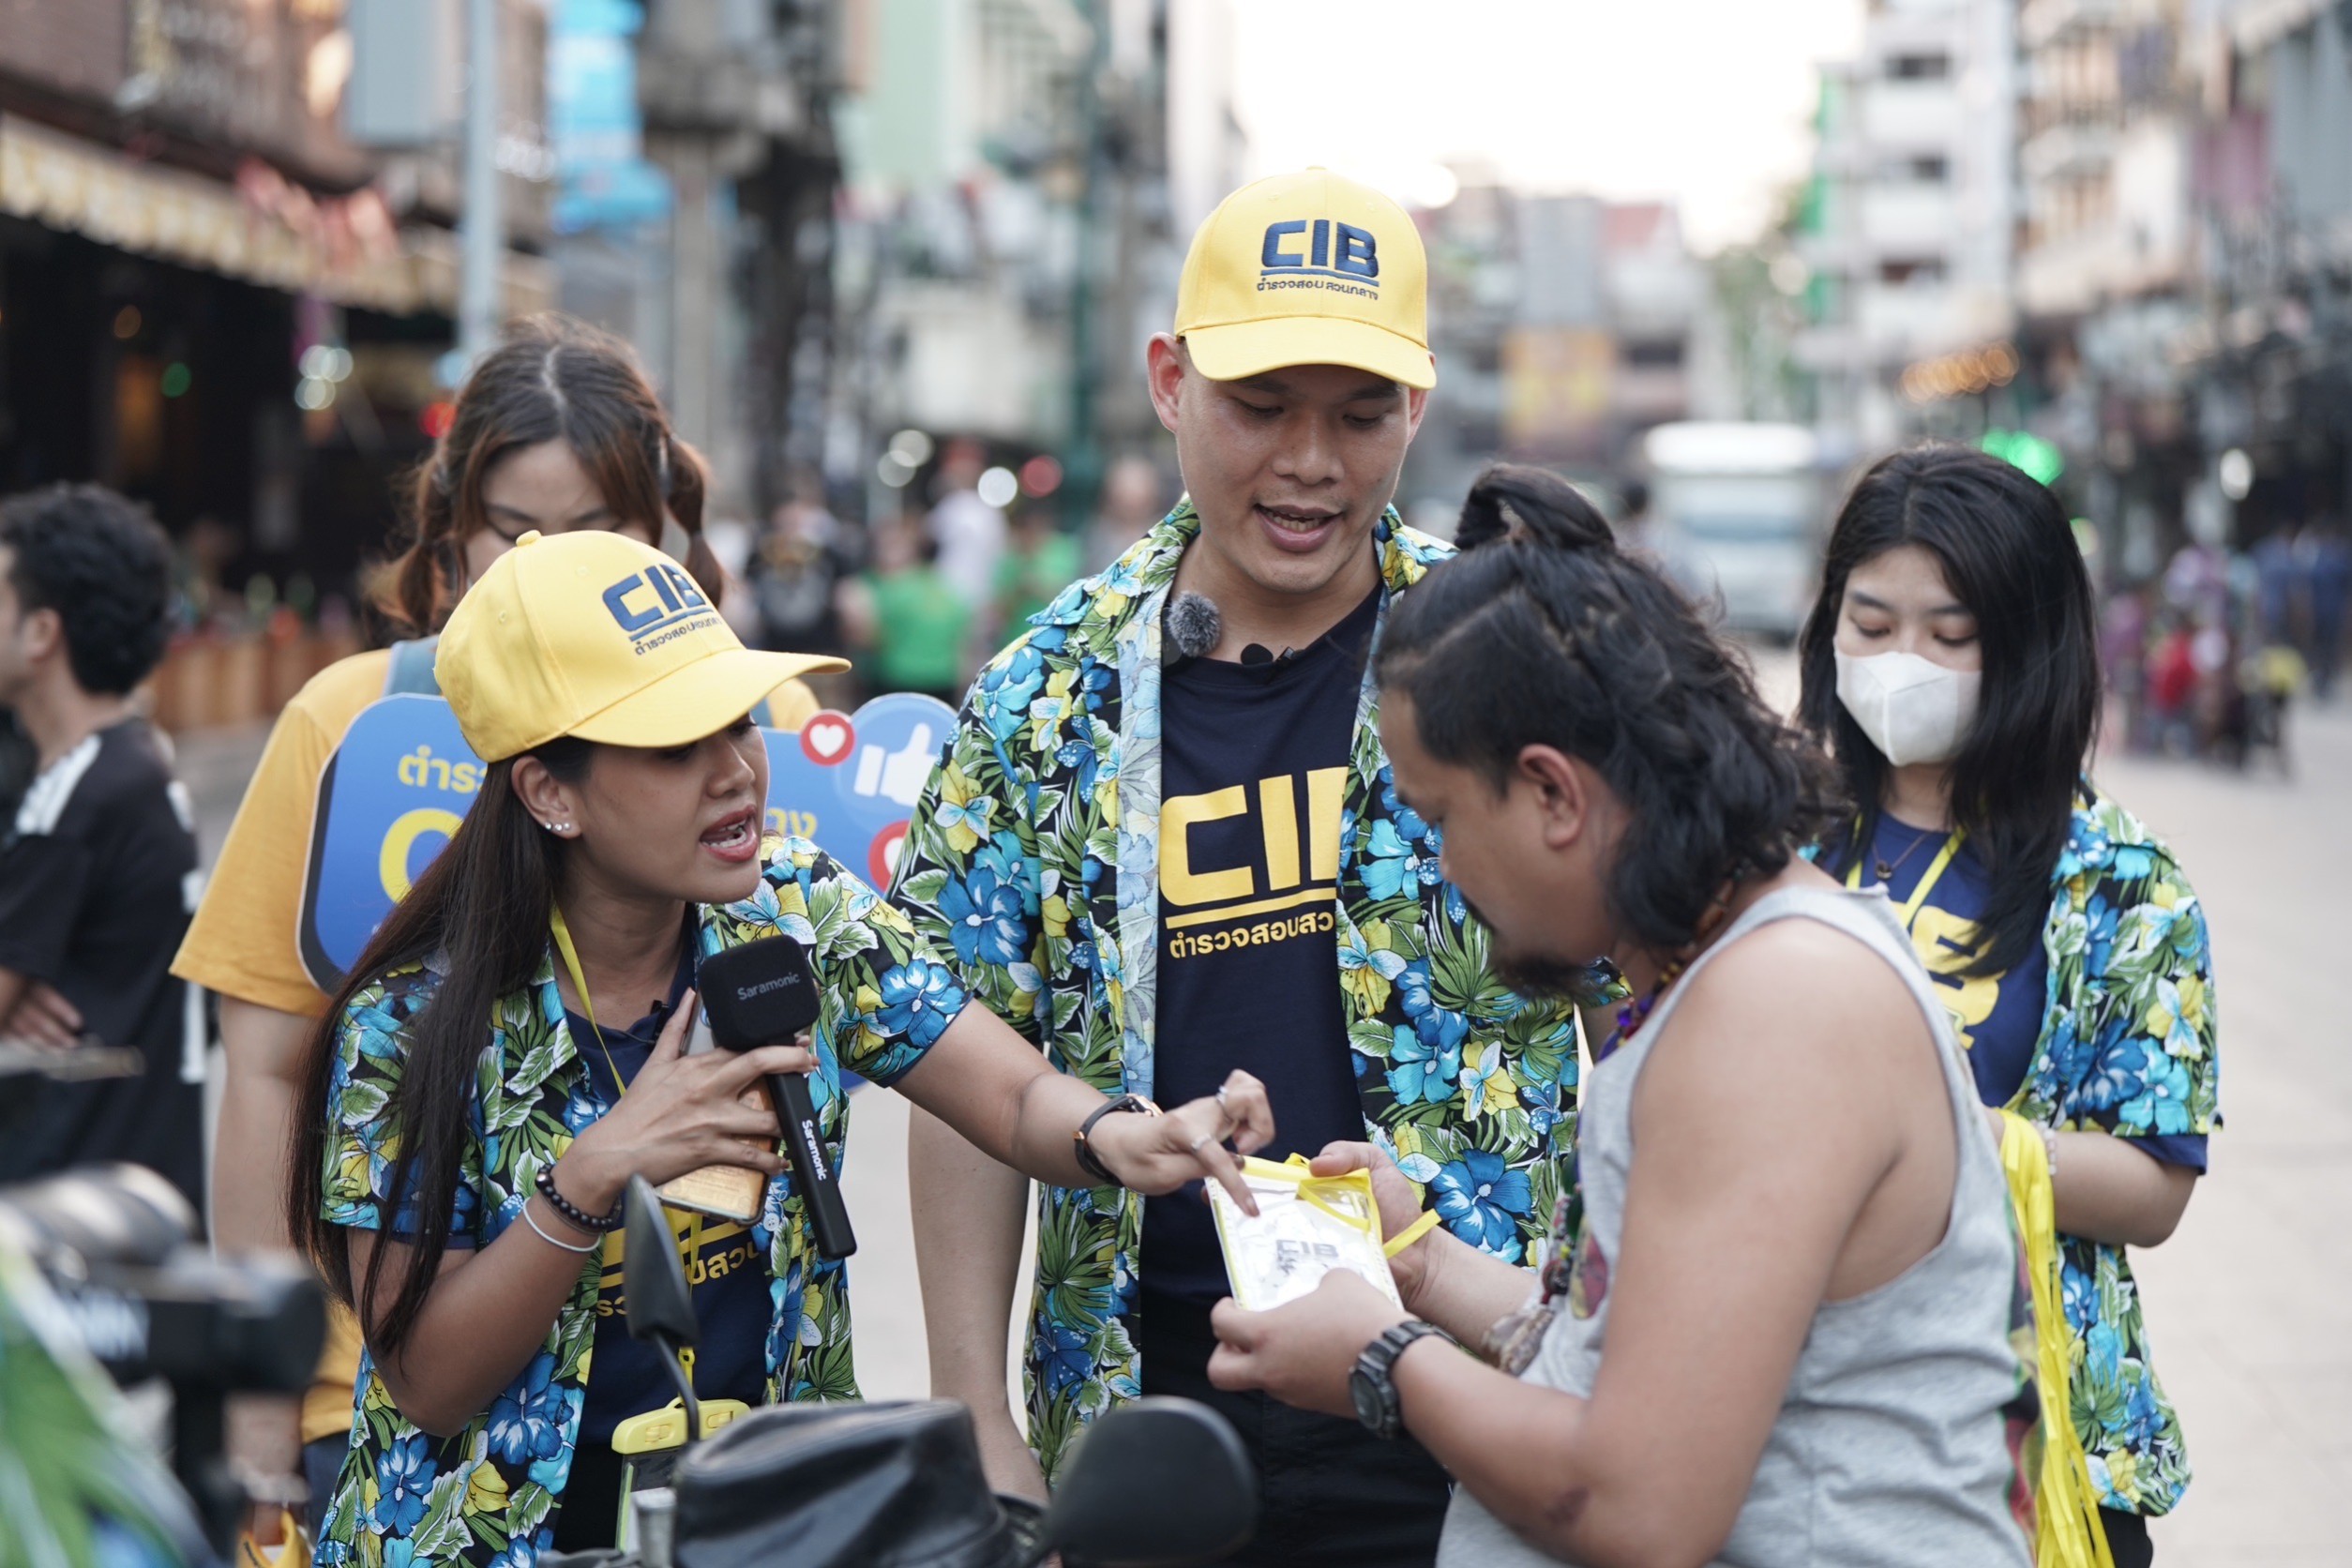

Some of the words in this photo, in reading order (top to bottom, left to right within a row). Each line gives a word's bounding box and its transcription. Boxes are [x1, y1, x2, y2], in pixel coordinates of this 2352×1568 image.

[1261, 219, 1380, 279] CIB
[602, 564, 706, 632] CIB
[737, 972, 801, 1001] Saramonic
[801, 1119, 827, 1182] Saramonic
[1275, 1238, 1339, 1259] CIB
